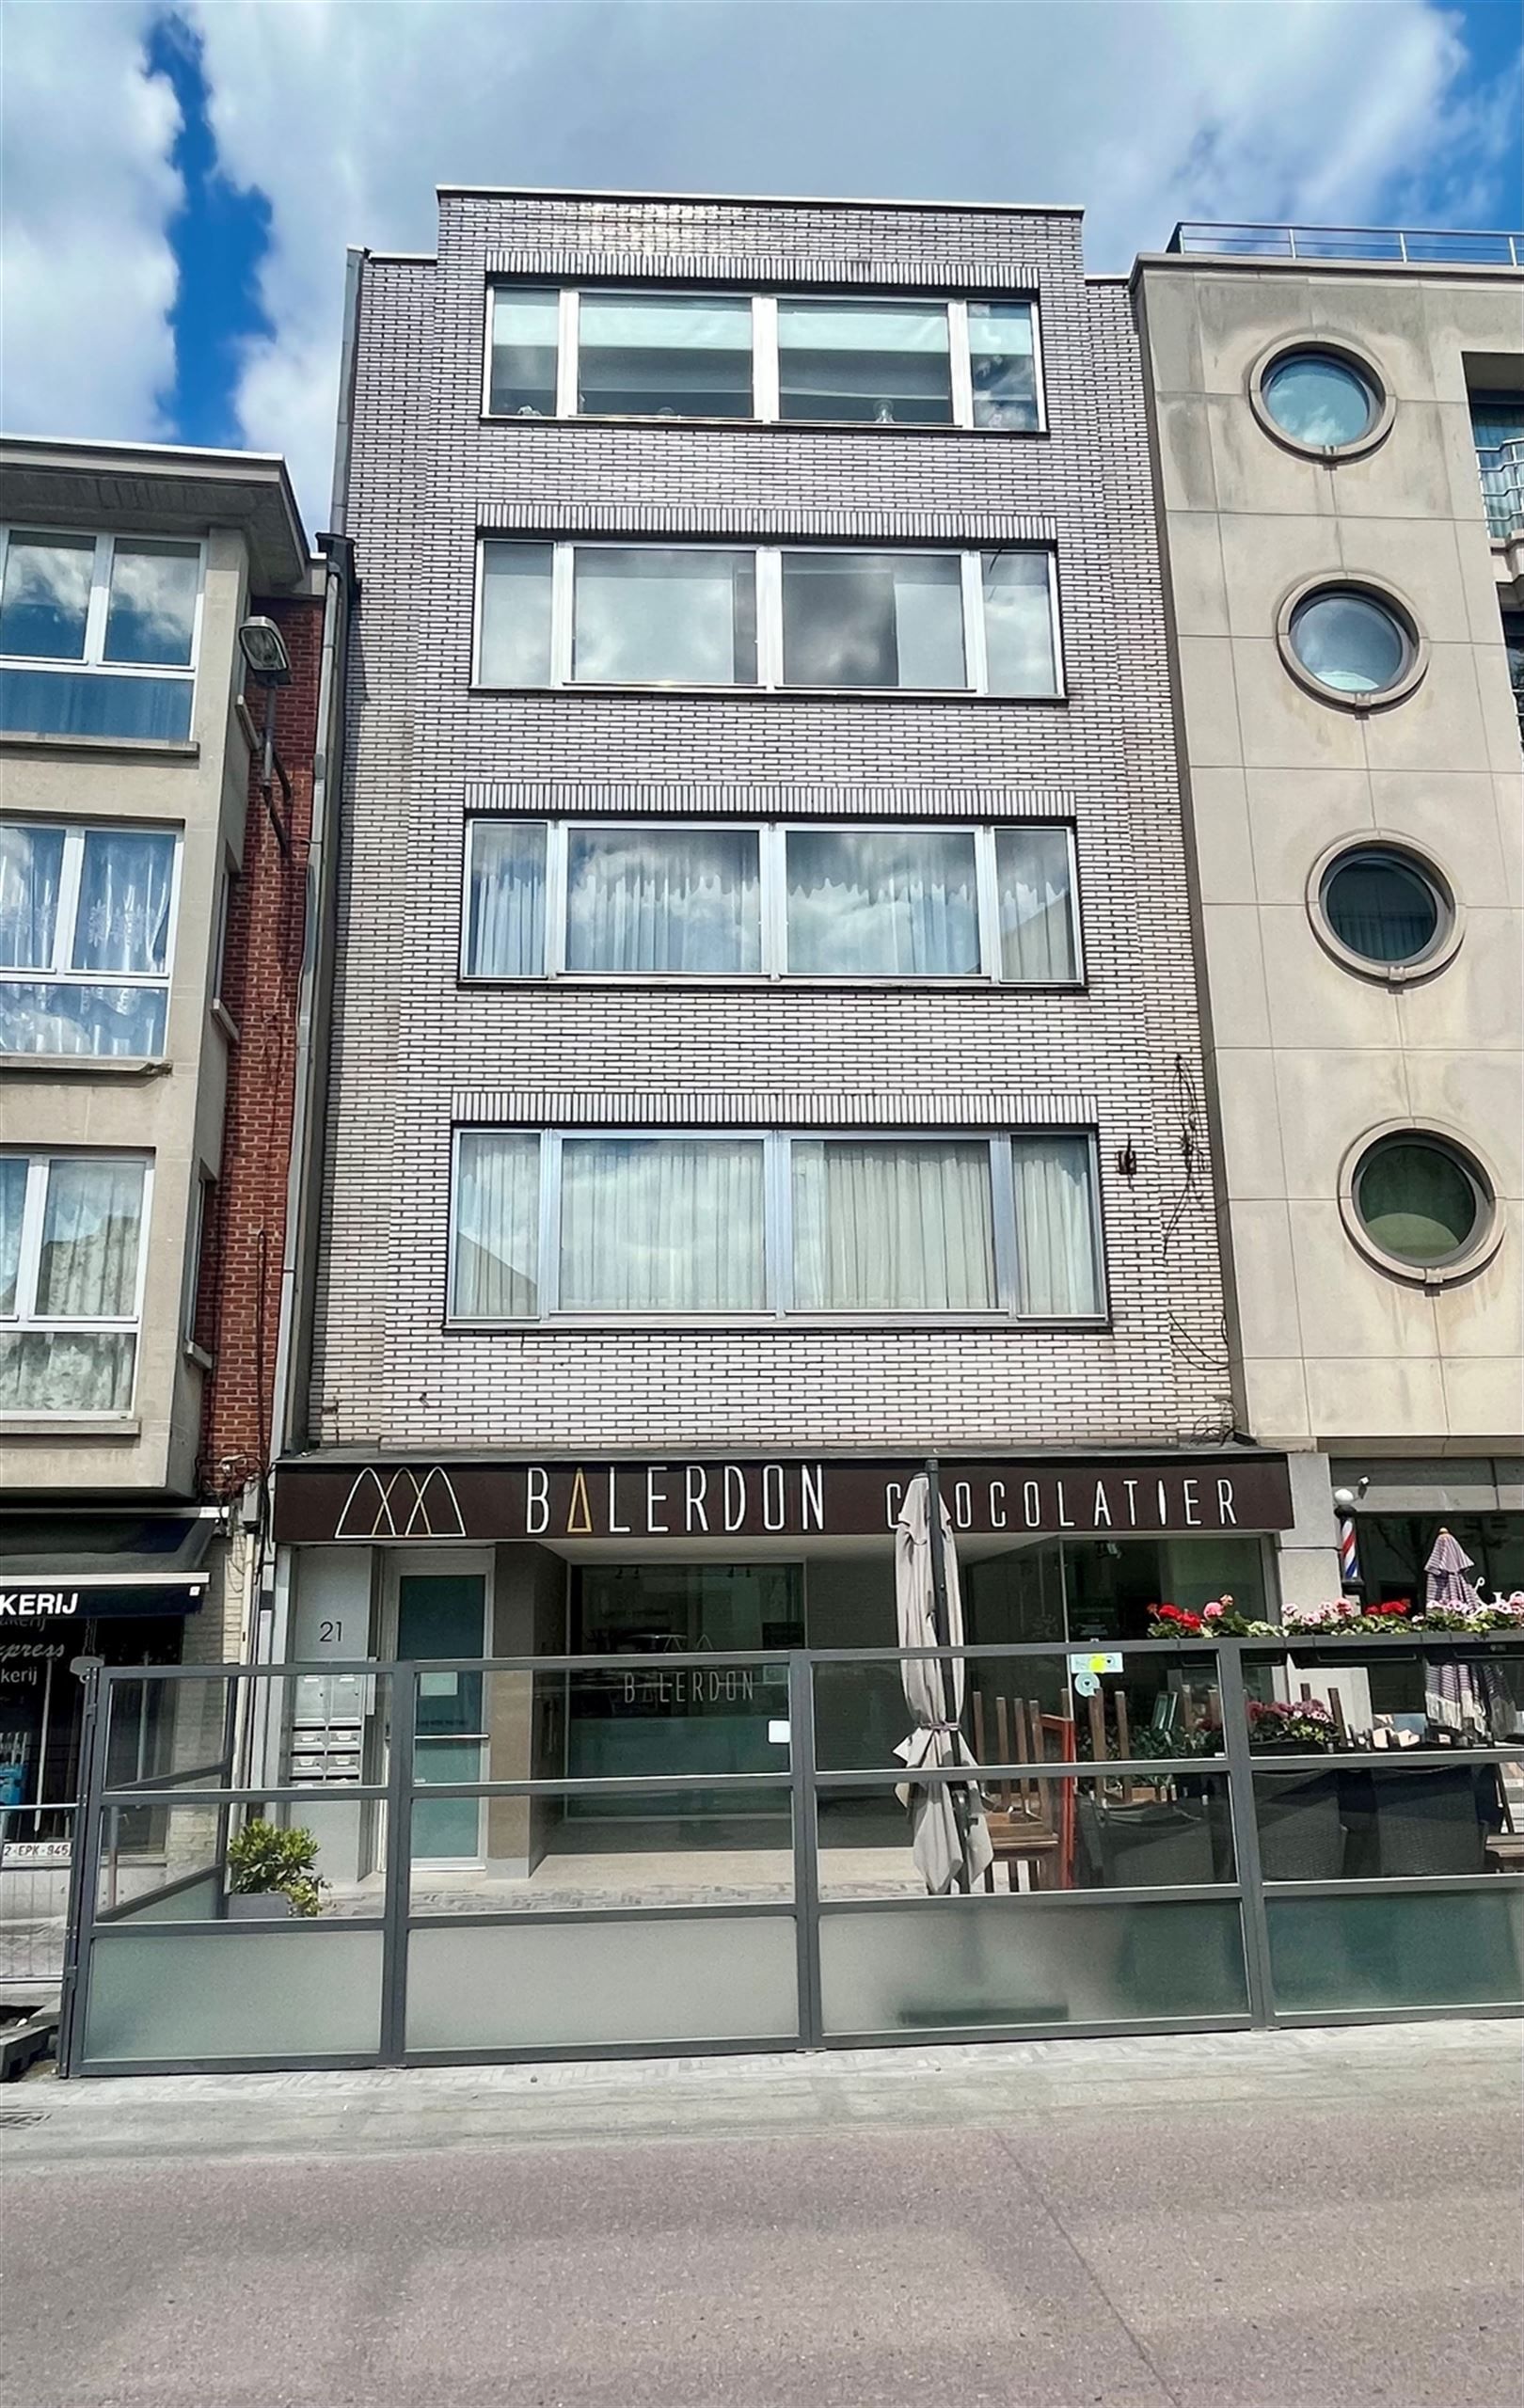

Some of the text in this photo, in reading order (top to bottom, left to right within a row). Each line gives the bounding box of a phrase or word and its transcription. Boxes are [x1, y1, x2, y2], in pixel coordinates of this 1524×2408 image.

[526, 1464, 1237, 1534] BALERDON COCOLATIER
[0, 1592, 79, 1616] KERIJ
[319, 1621, 342, 1642] 21
[0, 1667, 38, 1686] kerij
